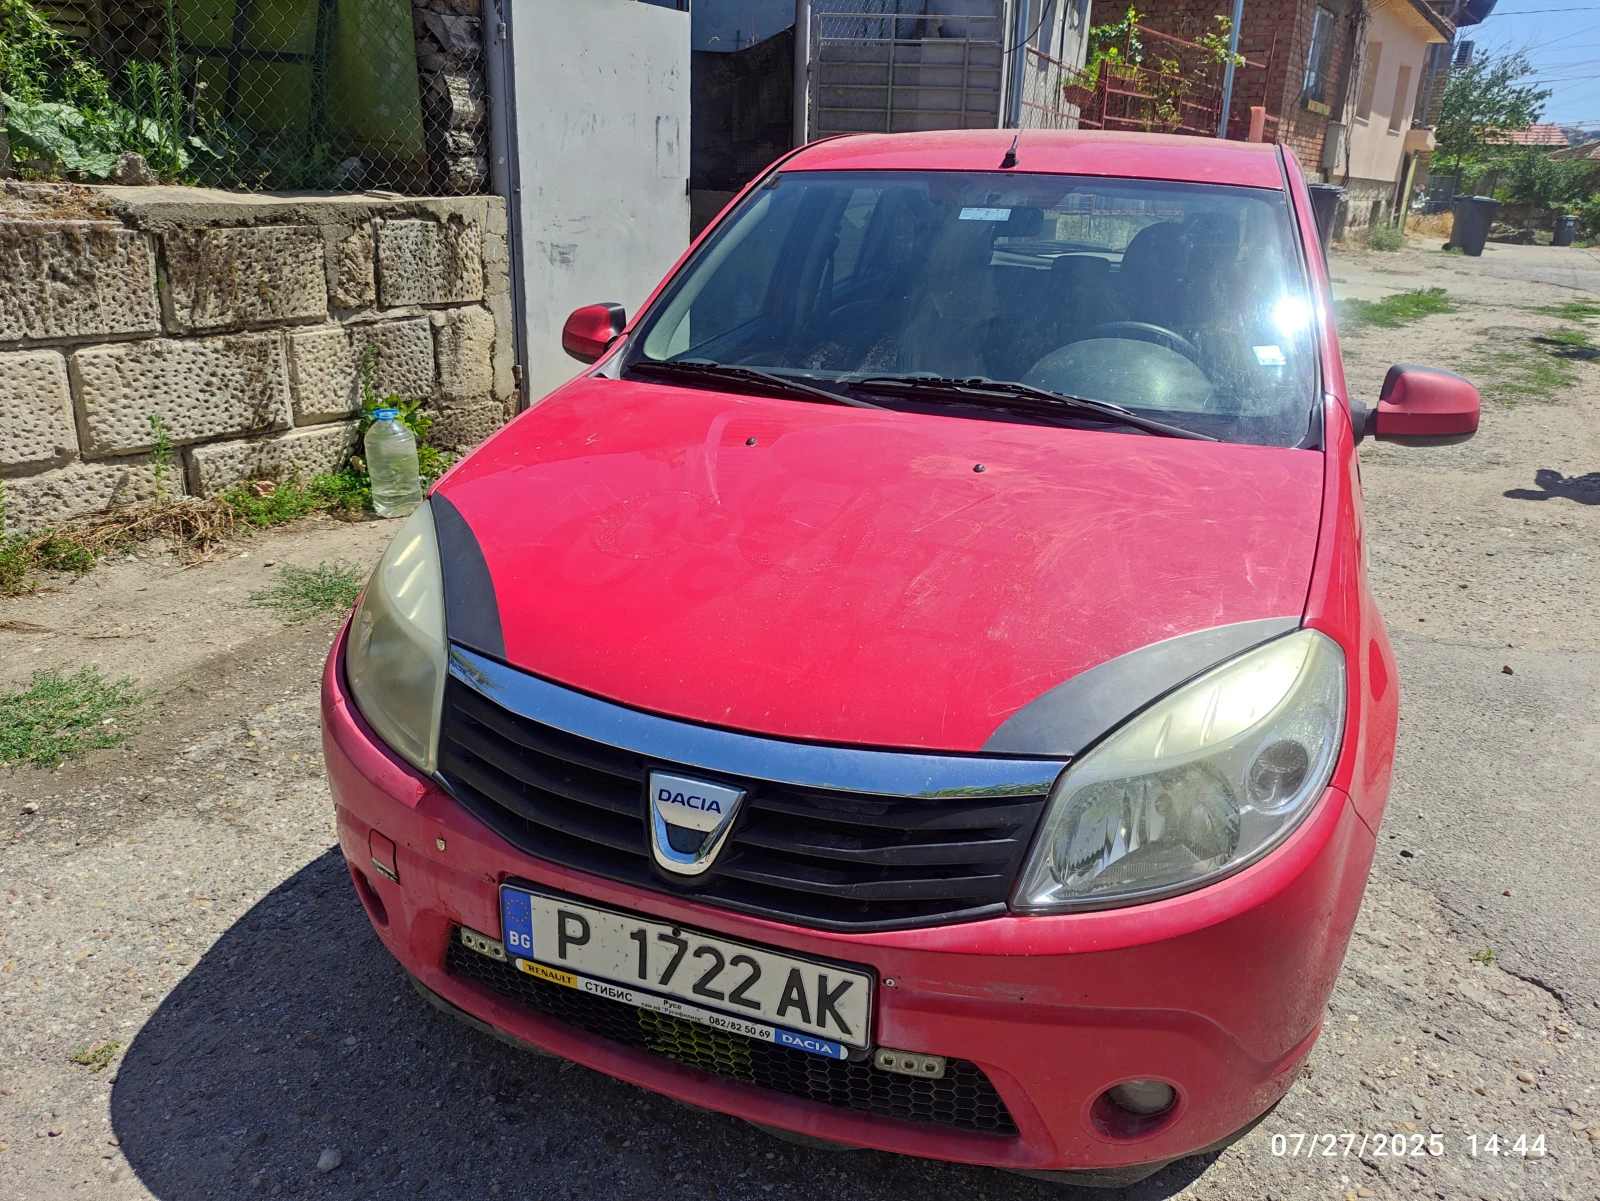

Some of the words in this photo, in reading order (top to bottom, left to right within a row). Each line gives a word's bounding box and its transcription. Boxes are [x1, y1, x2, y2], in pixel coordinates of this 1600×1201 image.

[658, 788, 722, 814] DACIA
[509, 930, 531, 949] BG
[526, 963, 573, 985] RENAULT
[557, 909, 591, 960] P
[629, 927, 761, 1010] 1722
[776, 967, 853, 1036] AK
[584, 981, 633, 1002] СТИБИС
[708, 1015, 742, 1032] 082/82
[744, 1025, 757, 1035] 50
[758, 1029, 771, 1039] 69
[781, 1033, 834, 1054] DACIA
